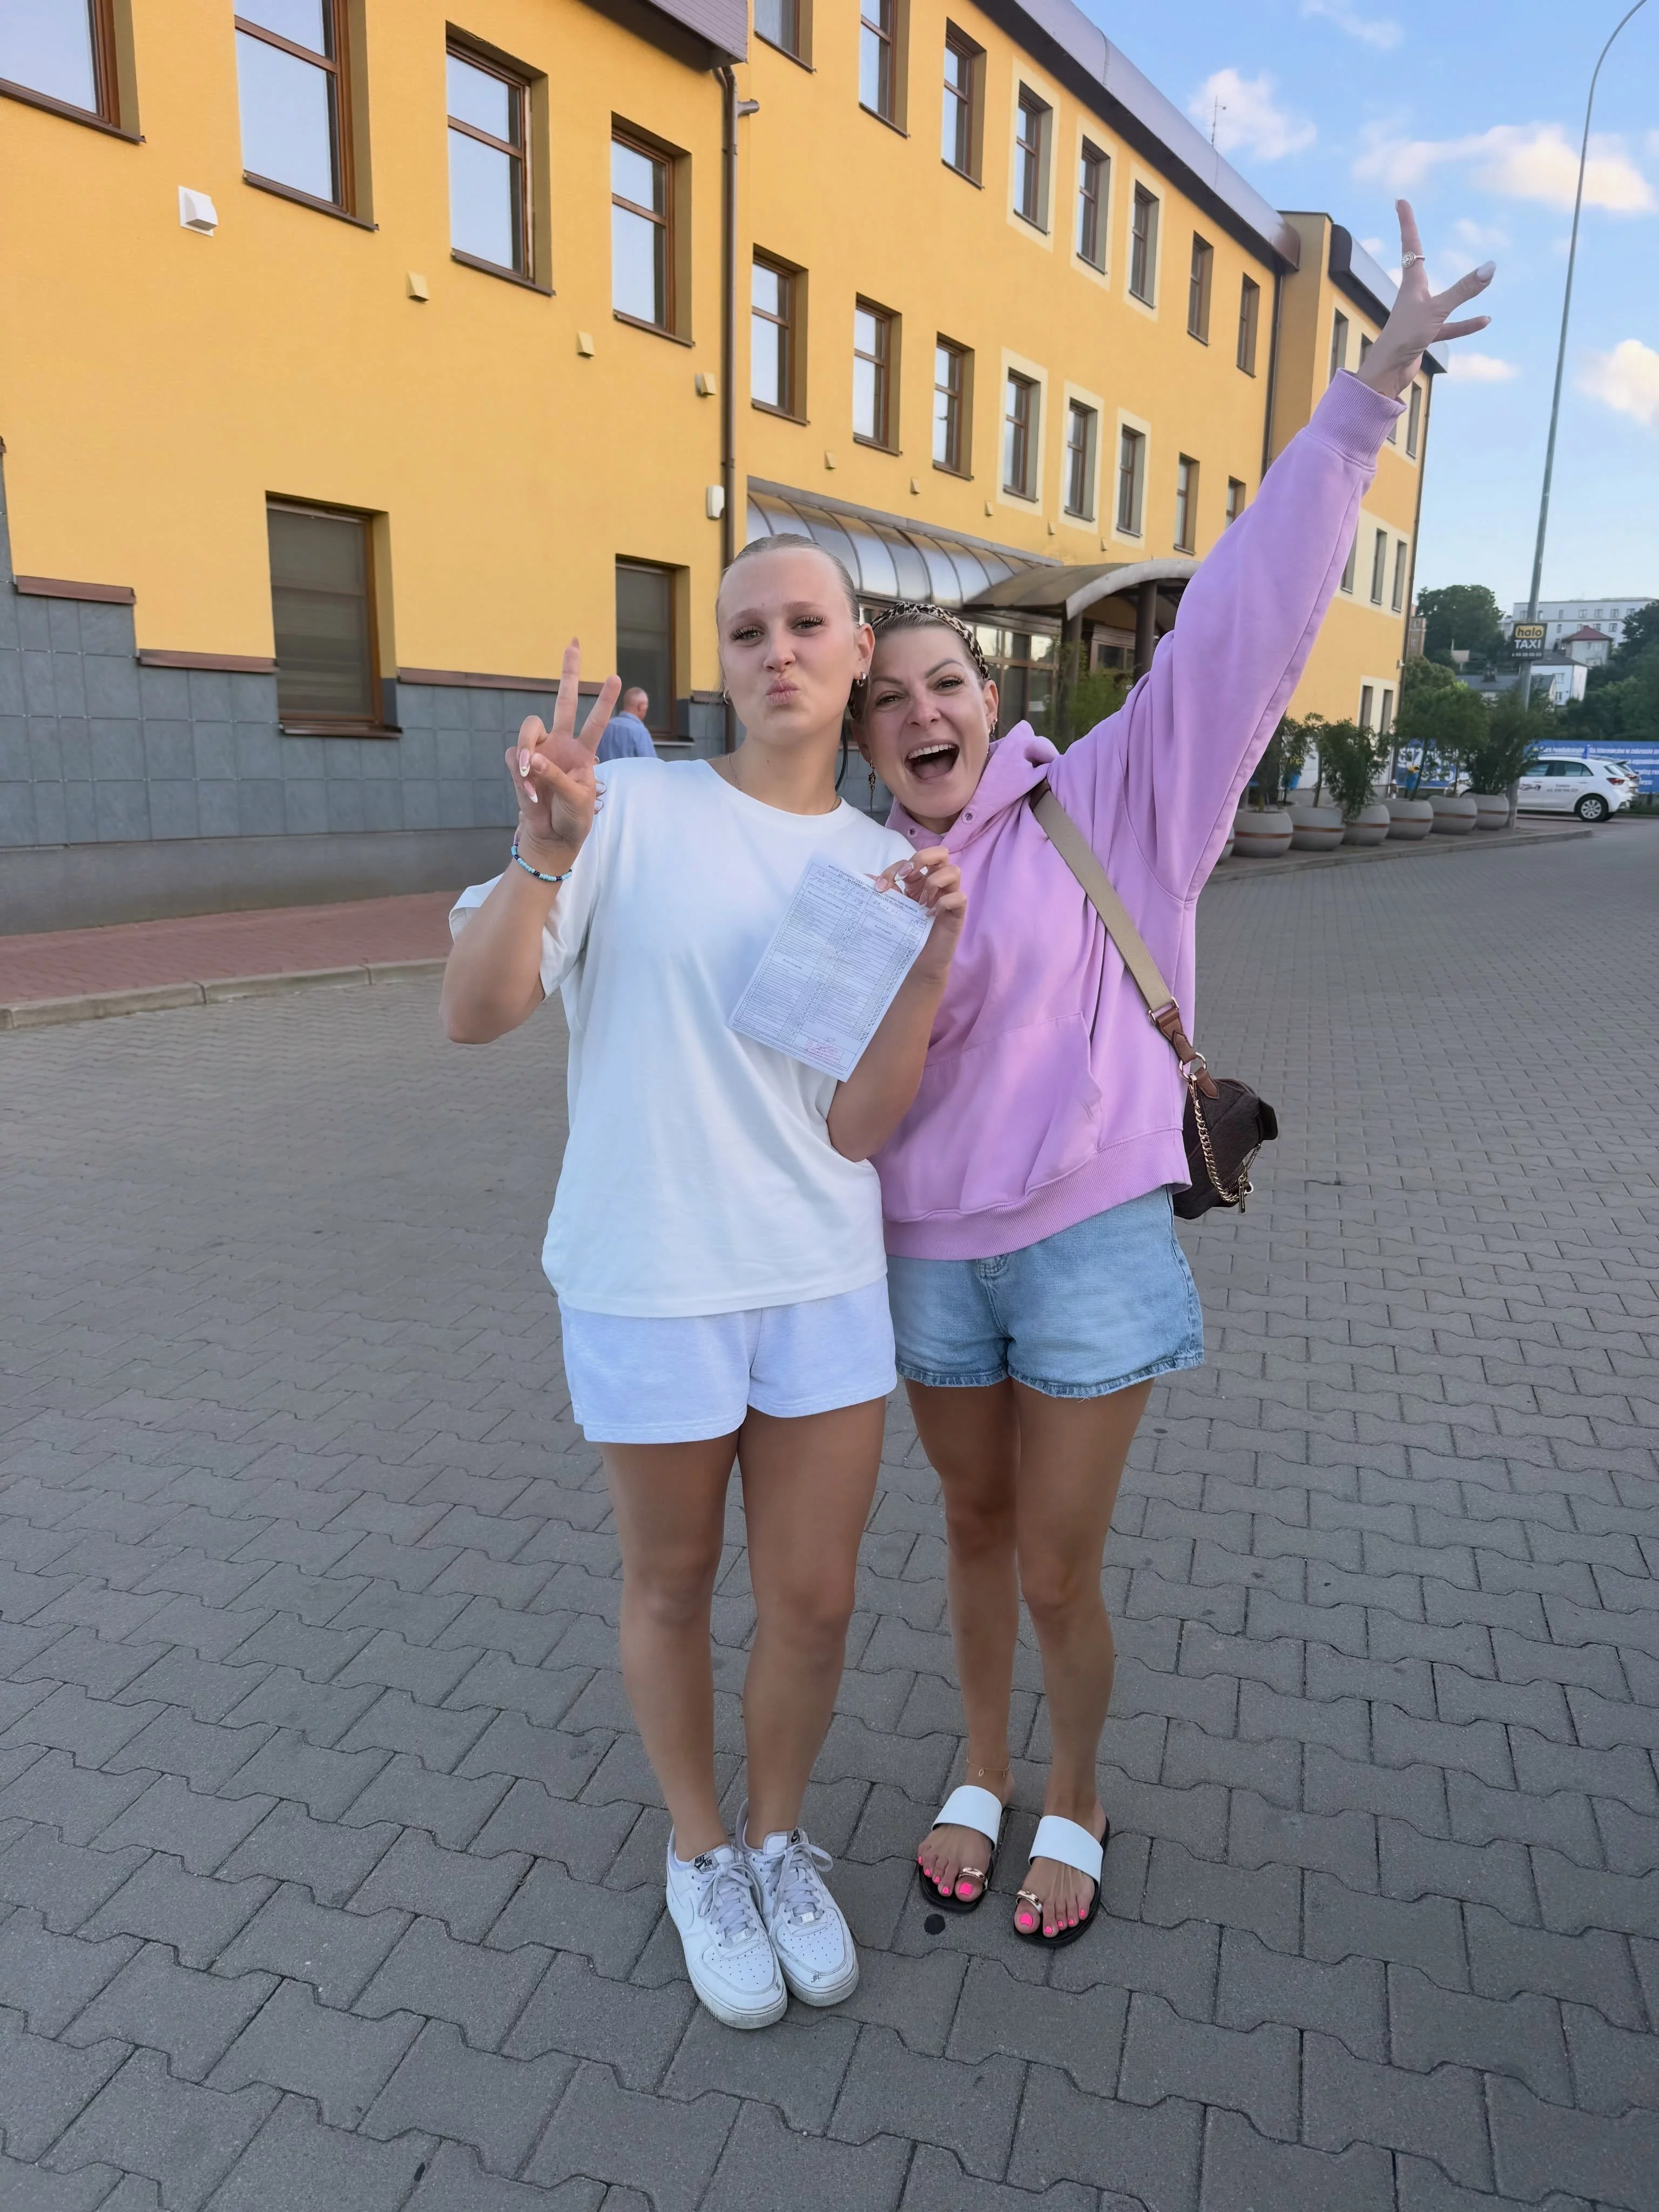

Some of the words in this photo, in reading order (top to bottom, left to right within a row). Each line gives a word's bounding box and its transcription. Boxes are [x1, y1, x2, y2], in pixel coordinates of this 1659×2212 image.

[1517, 627, 1542, 637] halo
[1514, 639, 1541, 649] TAXI
[694, 1854, 705, 1864] NIKE
[704, 1859, 713, 1867] AIR
